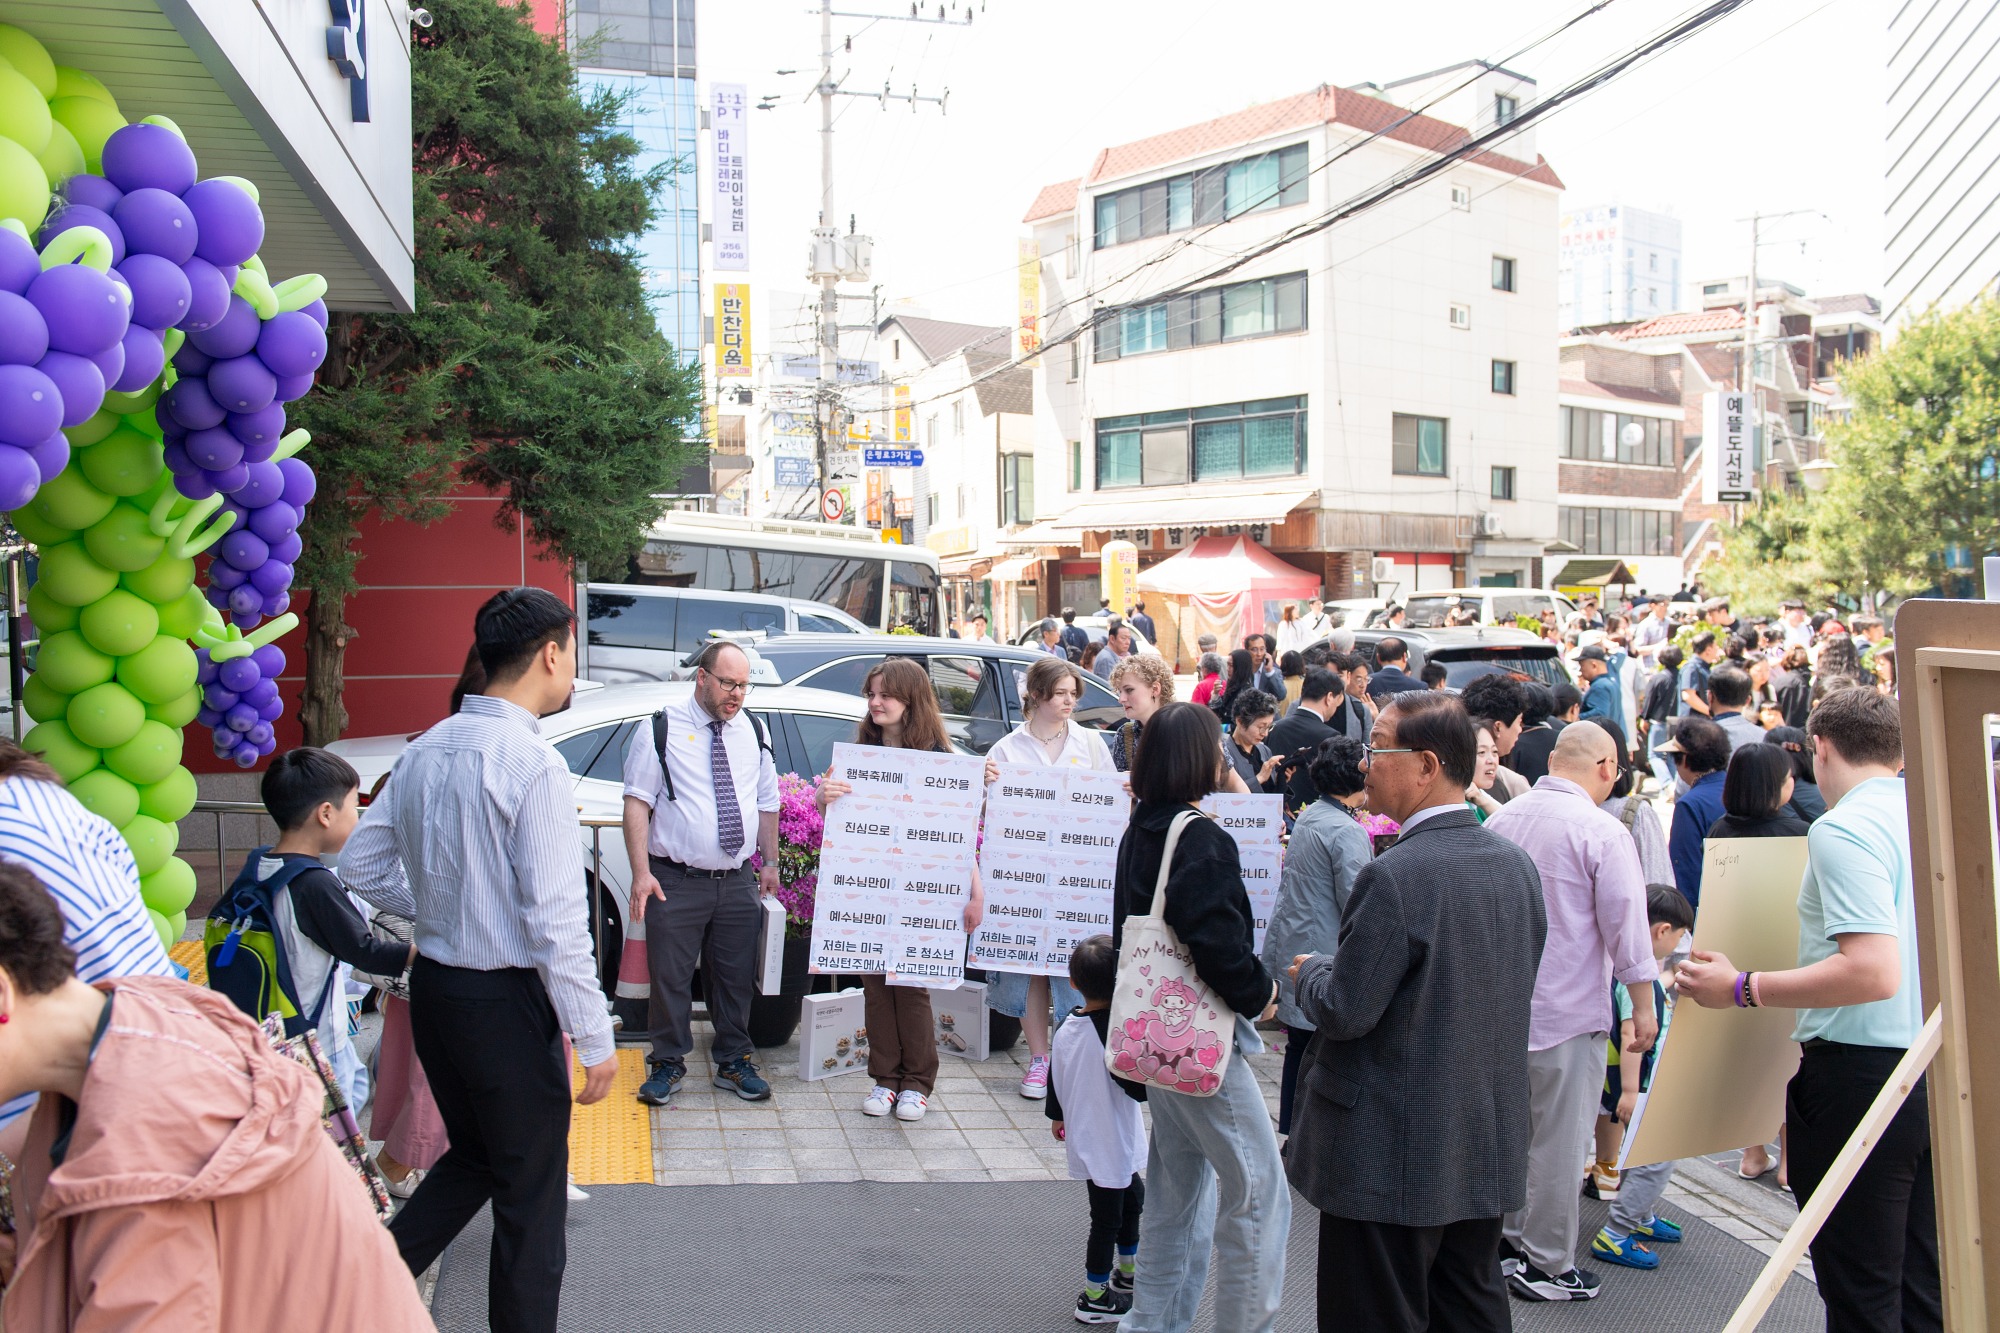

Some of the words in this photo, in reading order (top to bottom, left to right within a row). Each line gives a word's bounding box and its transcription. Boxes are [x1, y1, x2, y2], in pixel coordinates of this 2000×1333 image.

[717, 92, 742, 105] 1:1
[717, 129, 730, 193] 바디브레인
[731, 155, 744, 232] 트레이닝센터
[722, 242, 741, 250] 356
[722, 298, 743, 366] 반찬다움
[1726, 397, 1744, 488] 예뜰도서관
[829, 455, 858, 466] 견인지역
[866, 450, 911, 460] 은평로3가길
[846, 767, 903, 785] 행복축제에
[924, 775, 970, 791] 오신것을
[1002, 785, 1056, 801] 행복축제에
[1071, 791, 1114, 807] 오신것을
[844, 821, 890, 836] 진심으로
[906, 828, 966, 844] 환영합니다.
[1223, 817, 1266, 828] 오신것을
[1003, 827, 1046, 842] 진심으로
[1060, 832, 1117, 848] 환영합니다.
[833, 874, 890, 890] 예수님만이
[904, 880, 963, 896] 소망입니다.
[992, 868, 1045, 884] 예수님만이
[1058, 875, 1115, 890] 소망입니다.
[829, 910, 886, 925] 예수님만이
[900, 916, 960, 931] 구원입니다.
[989, 903, 1042, 919] 예수님만이
[1055, 910, 1111, 925] 구원입니다.
[822, 939, 857, 953] 저희는
[861, 941, 884, 954] 미국
[905, 946, 917, 958] 온
[921, 947, 954, 961] 청소년
[980, 931, 1012, 944] 저희는
[1015, 933, 1037, 946] 미국
[1056, 938, 1067, 949] 온
[817, 956, 886, 972] 워싱턴주에서
[975, 946, 1038, 962] 워싱턴주에서
[1131, 946, 1150, 963] My
